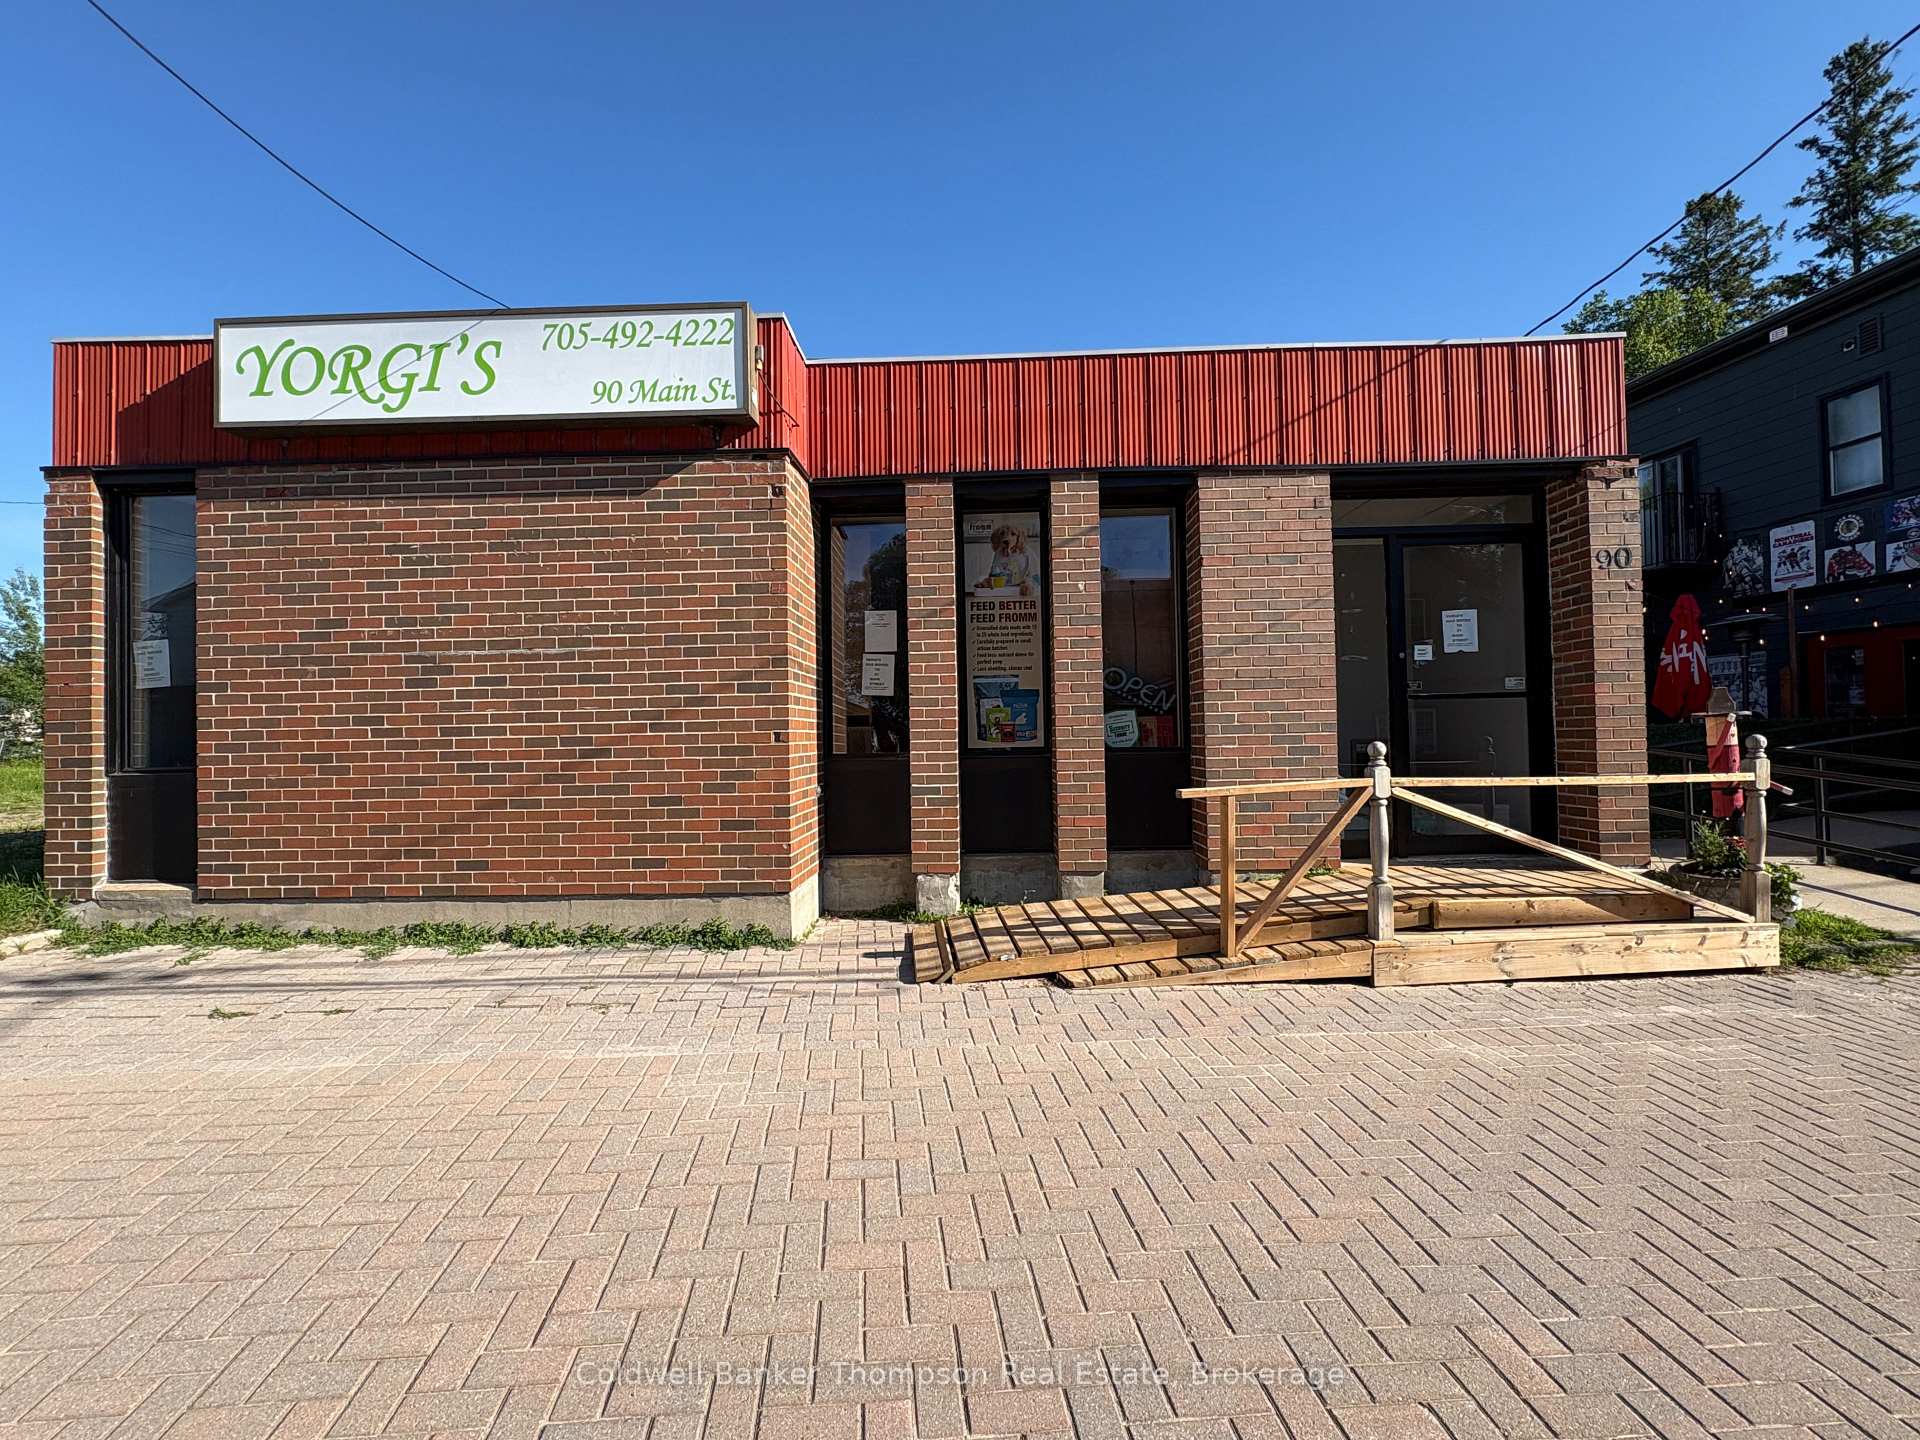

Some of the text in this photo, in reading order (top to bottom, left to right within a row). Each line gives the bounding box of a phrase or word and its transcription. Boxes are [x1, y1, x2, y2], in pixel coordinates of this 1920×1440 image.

[543, 318, 736, 351] 705-492-4222
[235, 333, 502, 413] YORGI'S
[591, 376, 736, 404] 90 Main St.
[1596, 545, 1632, 569] 90
[970, 600, 1037, 611] FEED BETTER
[970, 612, 1038, 623] FEED FROMM
[1103, 667, 1176, 711] OPEN
